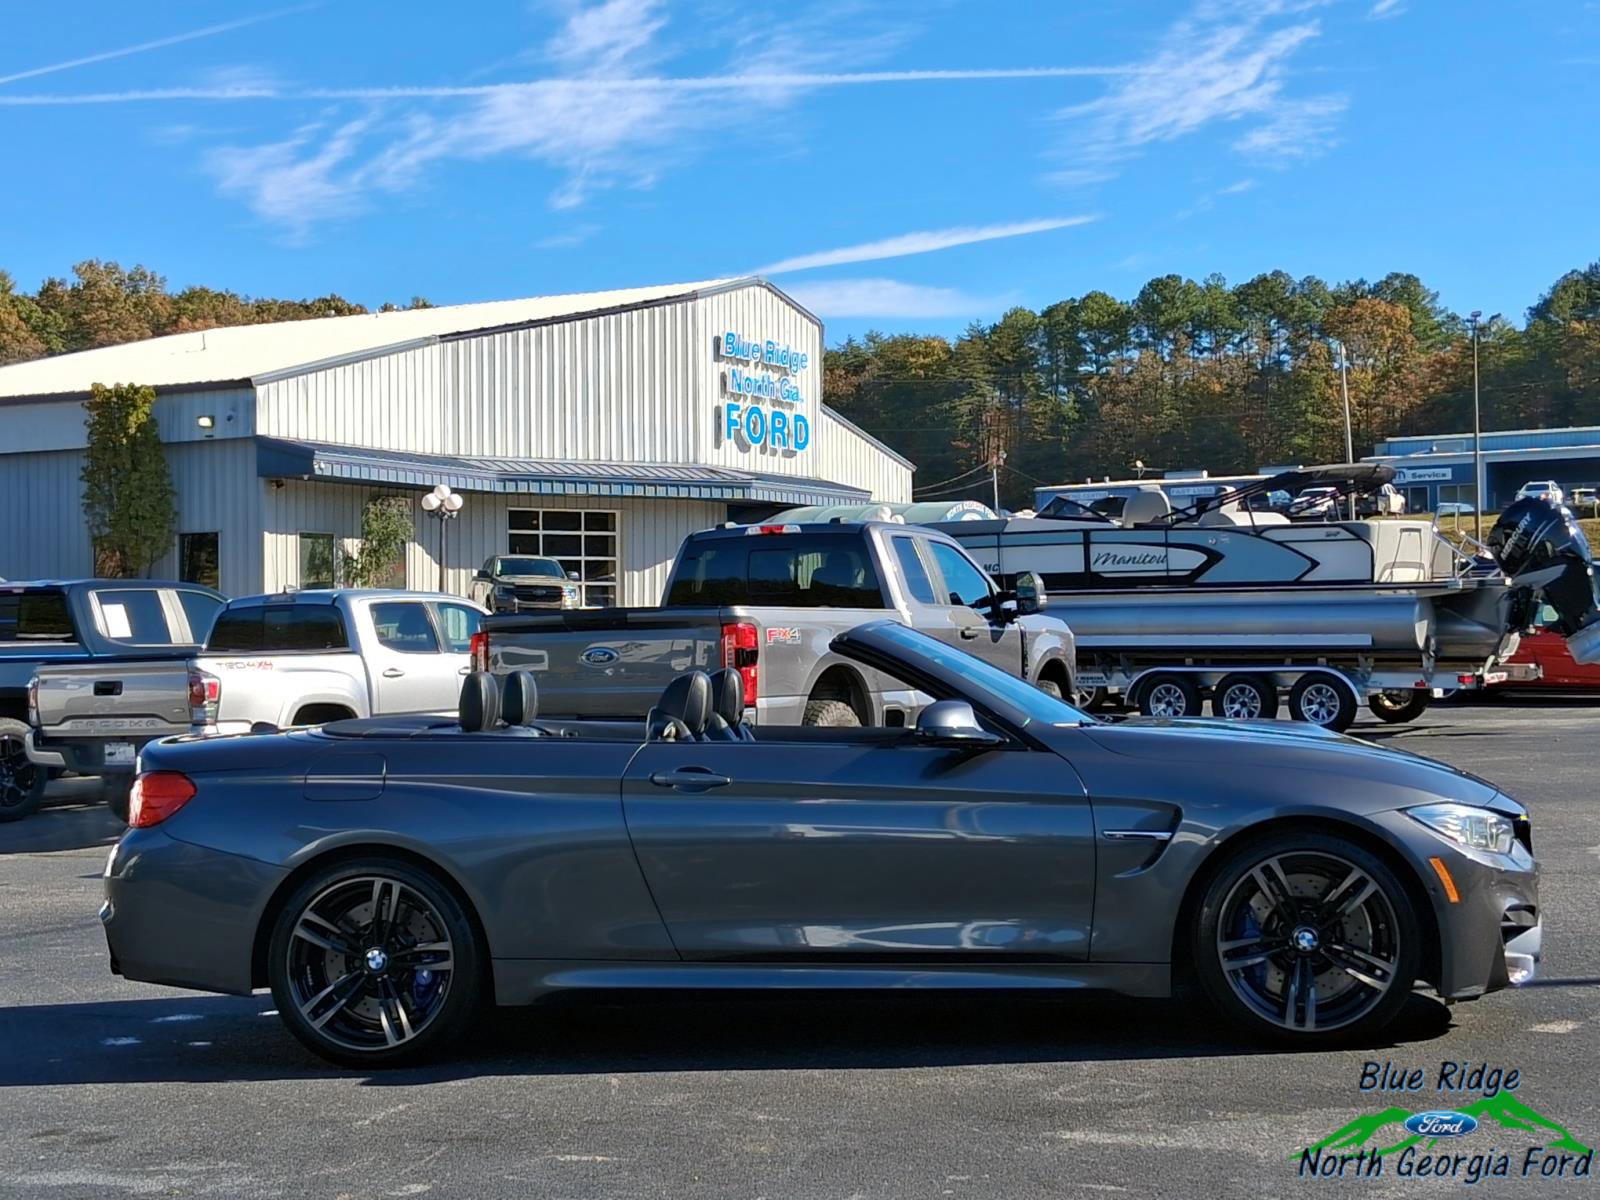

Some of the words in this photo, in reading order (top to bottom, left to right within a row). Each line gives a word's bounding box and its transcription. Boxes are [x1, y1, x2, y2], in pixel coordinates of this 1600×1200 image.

[725, 332, 760, 361] Blue
[765, 340, 808, 374] Ridge
[731, 368, 776, 398] North
[726, 403, 809, 451] FORD
[1411, 471, 1447, 480] Service
[1092, 552, 1167, 566] Manitou
[767, 628, 801, 642] FX4
